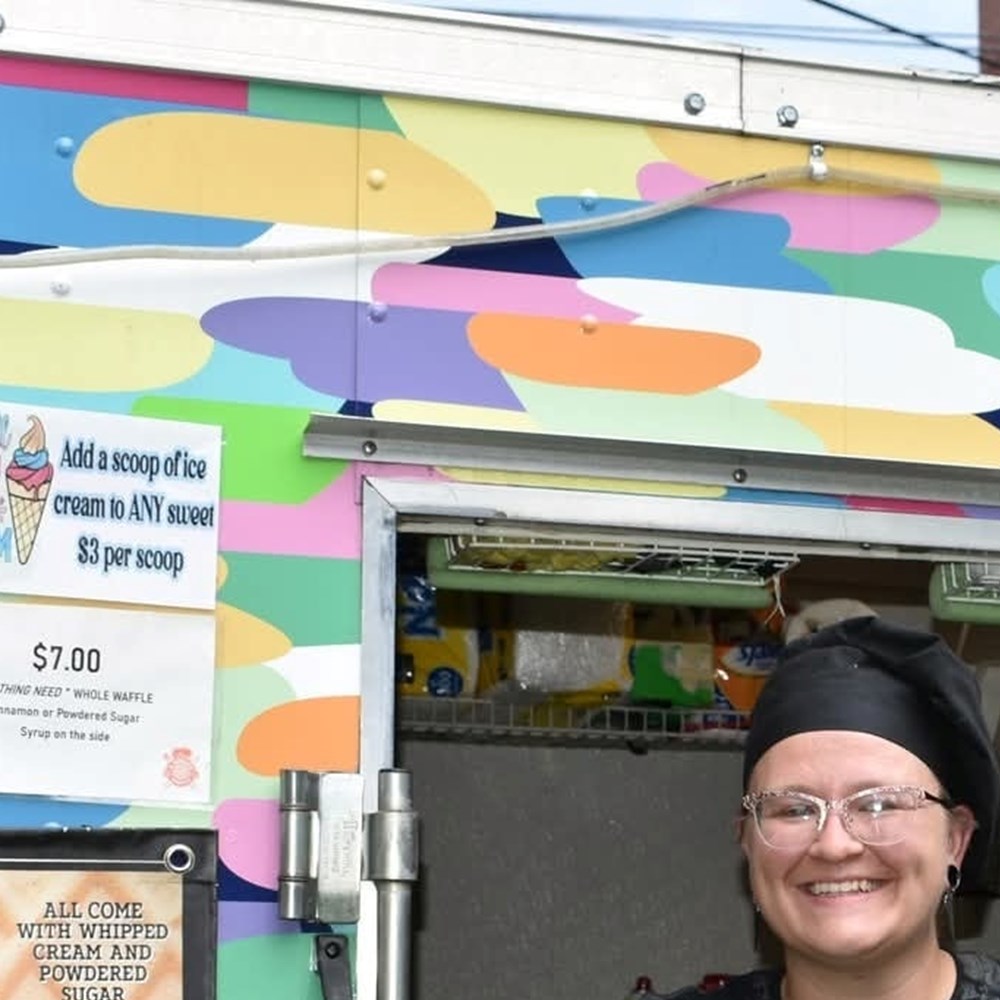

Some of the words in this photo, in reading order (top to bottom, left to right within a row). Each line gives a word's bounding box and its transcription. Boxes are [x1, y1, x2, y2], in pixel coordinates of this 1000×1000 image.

[60, 440, 94, 470] Add
[98, 452, 107, 475] a
[112, 453, 159, 482] scoop
[164, 451, 181, 477] of
[183, 452, 207, 479] ice
[54, 494, 105, 518] cream
[110, 500, 124, 520] to
[129, 494, 164, 523] ANY
[167, 502, 214, 527] sweet
[78, 536, 99, 564] $3
[104, 545, 131, 572] per
[136, 550, 184, 577] scoop
[33, 643, 100, 672] $7.00
[73, 689, 109, 701] WHOLE
[113, 691, 153, 704] WAFFLE
[42, 709, 54, 718] or
[57, 707, 107, 721] Powdered
[110, 711, 140, 725] Sugar
[20, 726, 50, 739] Syrup
[54, 730, 66, 739] on
[70, 730, 85, 740] the
[89, 731, 110, 741] side
[43, 902, 82, 919] ALL
[88, 902, 143, 919] COME
[17, 922, 71, 939] WITH
[80, 923, 168, 939] WHIPPED
[33, 943, 101, 960] CREAM
[109, 944, 151, 960] AND
[39, 965, 147, 981] POWDERED
